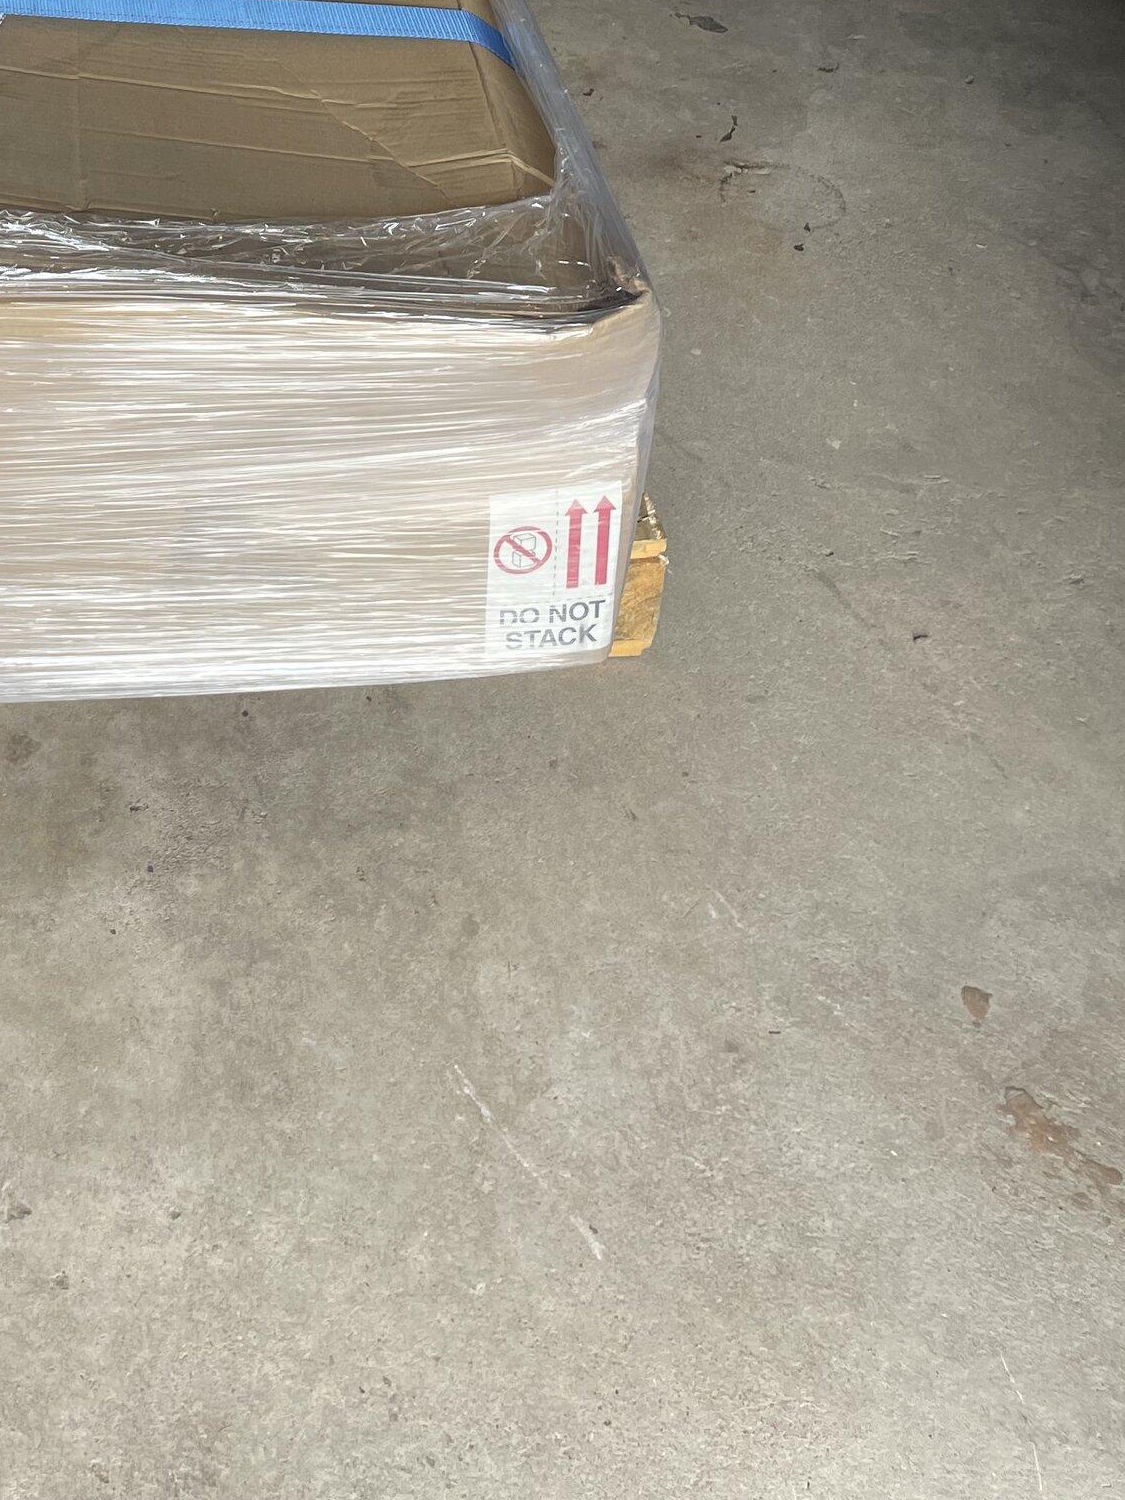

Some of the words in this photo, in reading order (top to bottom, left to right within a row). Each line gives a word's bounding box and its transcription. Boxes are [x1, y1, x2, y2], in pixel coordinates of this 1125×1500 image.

[499, 607, 540, 626] DO
[549, 600, 606, 624] NOT
[505, 624, 598, 650] STACK
